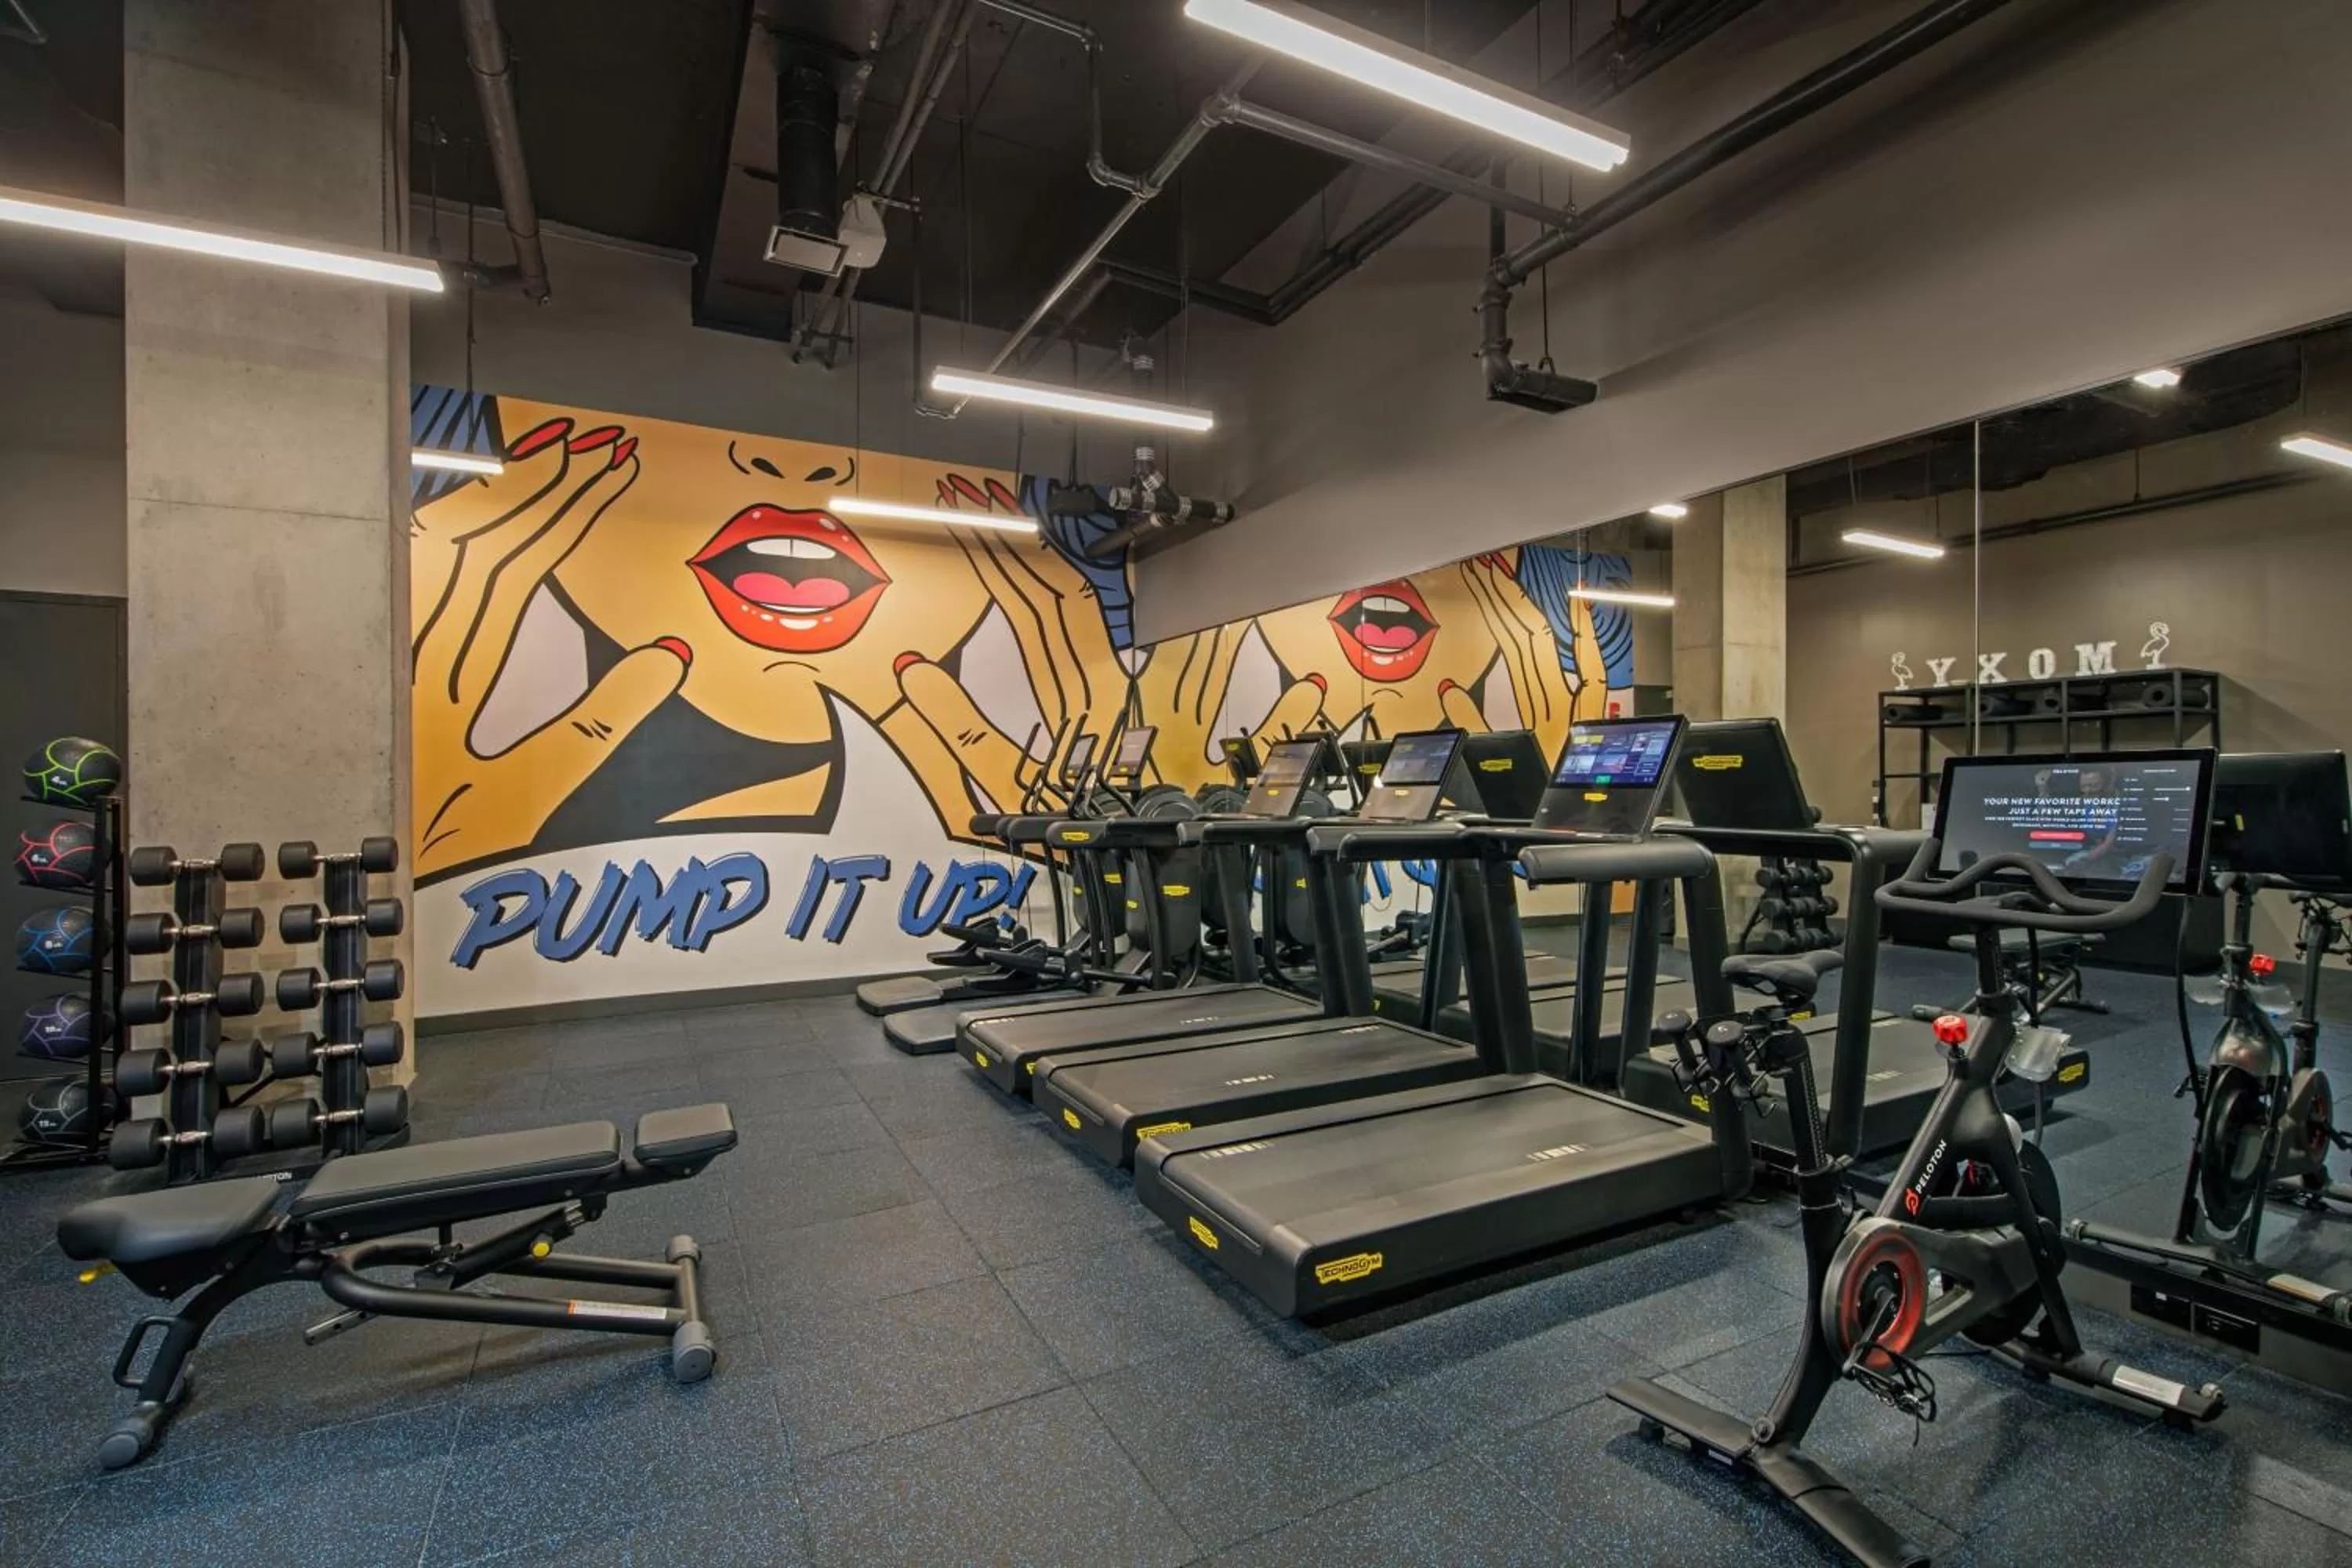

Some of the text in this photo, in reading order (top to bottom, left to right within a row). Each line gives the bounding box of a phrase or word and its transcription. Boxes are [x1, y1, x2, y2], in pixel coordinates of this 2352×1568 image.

[450, 852, 1038, 971] PUMP IT UP!
[1915, 1138, 1947, 1194] PELOTON
[1316, 1253, 1382, 1282] TECHNOGYM
